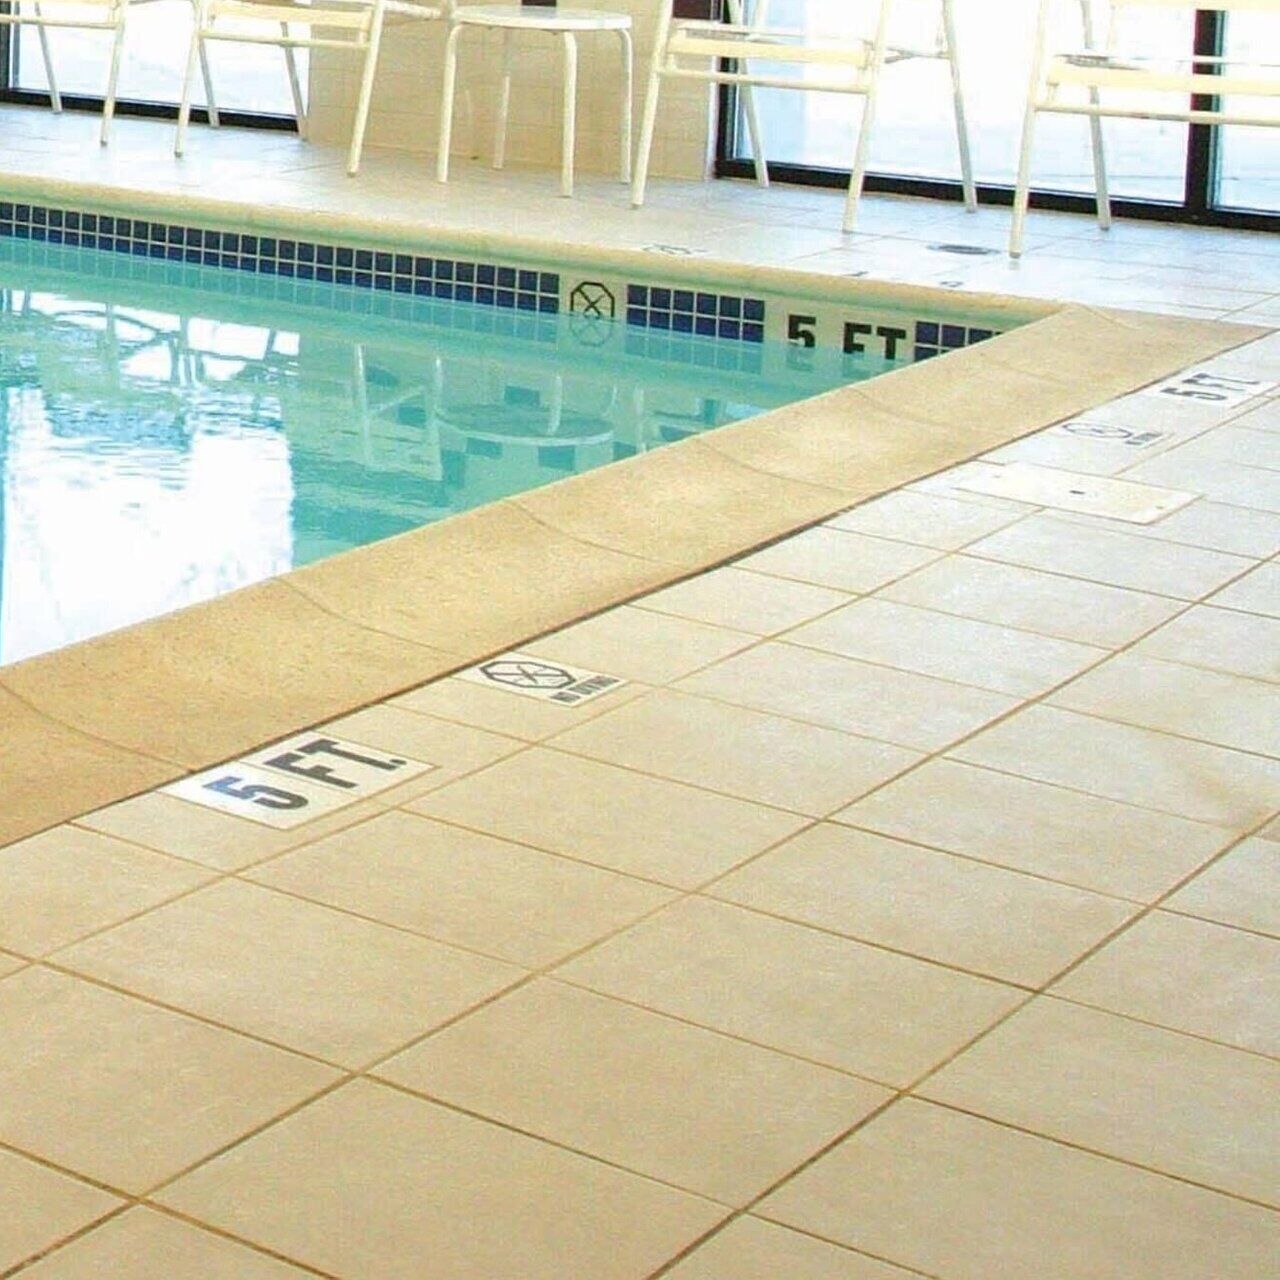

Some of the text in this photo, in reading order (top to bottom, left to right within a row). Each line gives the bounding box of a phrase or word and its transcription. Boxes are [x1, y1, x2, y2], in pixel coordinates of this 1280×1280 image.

[787, 314, 908, 360] 5 FT
[1160, 386, 1228, 402] 5
[202, 775, 310, 811] 5
